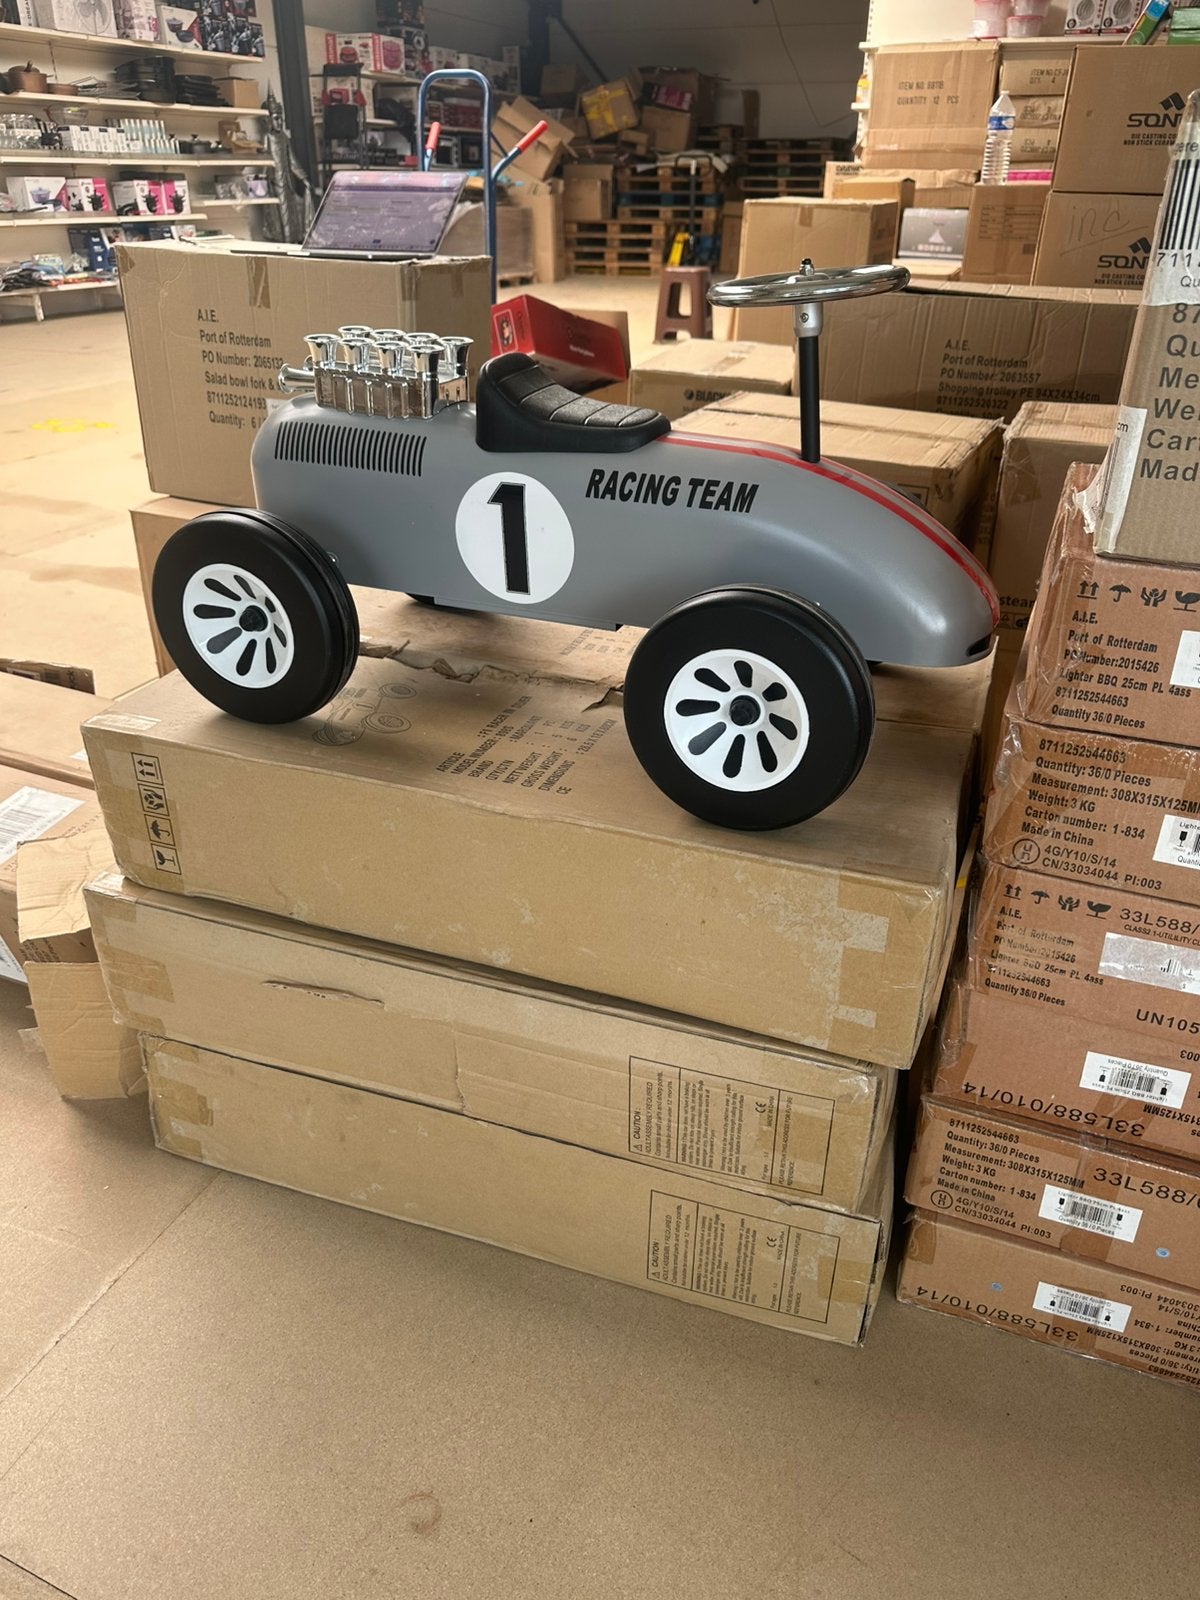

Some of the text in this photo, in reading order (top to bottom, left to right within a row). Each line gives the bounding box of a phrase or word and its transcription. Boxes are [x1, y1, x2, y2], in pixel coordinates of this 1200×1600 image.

[197, 308, 219, 322] A.I.E.
[200, 330, 271, 348] Port of Rotterdam
[945, 340, 970, 351] A.I.E.
[202, 350, 214, 362] PO
[216, 352, 251, 367] Number:
[942, 353, 1028, 369] Port of Rotterdam
[205, 371, 228, 385] Salad
[229, 376, 248, 388] bowl
[250, 379, 267, 390] fork
[268, 380, 275, 391] &
[940, 367, 955, 379] PO
[938, 381, 984, 397] Shopping
[985, 384, 1019, 398] trolley
[1020, 387, 1034, 397] PE
[209, 410, 257, 429] Quantity: 6
[1140, 458, 1199, 482] Mad
[585, 468, 759, 513] RACING TEAM
[487, 481, 531, 595] 1
[1072, 610, 1098, 624] A.I.E.
[1068, 630, 1158, 653] Port of Rotterdam
[1060, 668, 1192, 698] Lighter BBQ 25cm PL 4ass
[1055, 686, 1129, 708] 8711252544663
[1051, 704, 1145, 729] Quantity 36/0 Pieces
[436, 752, 465, 772] ARTICLE
[1039, 738, 1126, 764] 8711252544663
[450, 758, 477, 774] MODEL
[468, 760, 494, 777] BRAND
[521, 751, 563, 787] GROSS WEIGHT
[538, 760, 575, 791] DIMENSIONS
[1035, 756, 1151, 787] Quantity: 36/0 Pieces
[556, 786, 572, 794] CE
[1032, 773, 1108, 798] Measurement:
[1028, 789, 1095, 812] Weight: 3 KG
[1025, 806, 1060, 823] Carton
[1063, 815, 1107, 832] number:
[1021, 821, 1094, 847] Made in China
[1044, 845, 1117, 868] 4G/Y10/S/14
[1042, 857, 1162, 890] CN/33034044 PI:003
[1000, 906, 1022, 920] A.I.E.
[1044, 964, 1067, 977] 25cm
[1070, 970, 1081, 980] PL
[1083, 974, 1105, 986] 4ass
[984, 977, 1066, 1006] Quantity 36/0 Pieces
[963, 1082, 1145, 1137] 33L588/010/14
[949, 1118, 1020, 1144] 8711252544663
[946, 1131, 1040, 1163] Quantity: 36/0 Pieces
[942, 1155, 997, 1177] Weight: 3 KG
[944, 1142, 1085, 1189] Measurement: 308X315X125MM
[937, 1178, 996, 1202] Made in China
[939, 1167, 969, 1183] Carton
[970, 1175, 1006, 1192] number:
[956, 1196, 1015, 1219] 4G/Y10/S/14
[954, 1206, 1052, 1239] CN/33034044 PI:003
[1120, 1284, 1153, 1299] PI:003
[916, 1285, 1079, 1342] 33L588/010/14
[1086, 1327, 1162, 1353] 308X315X125MM
[1174, 1341, 1188, 1350] KG
[1129, 1349, 1159, 1362] Pieces
